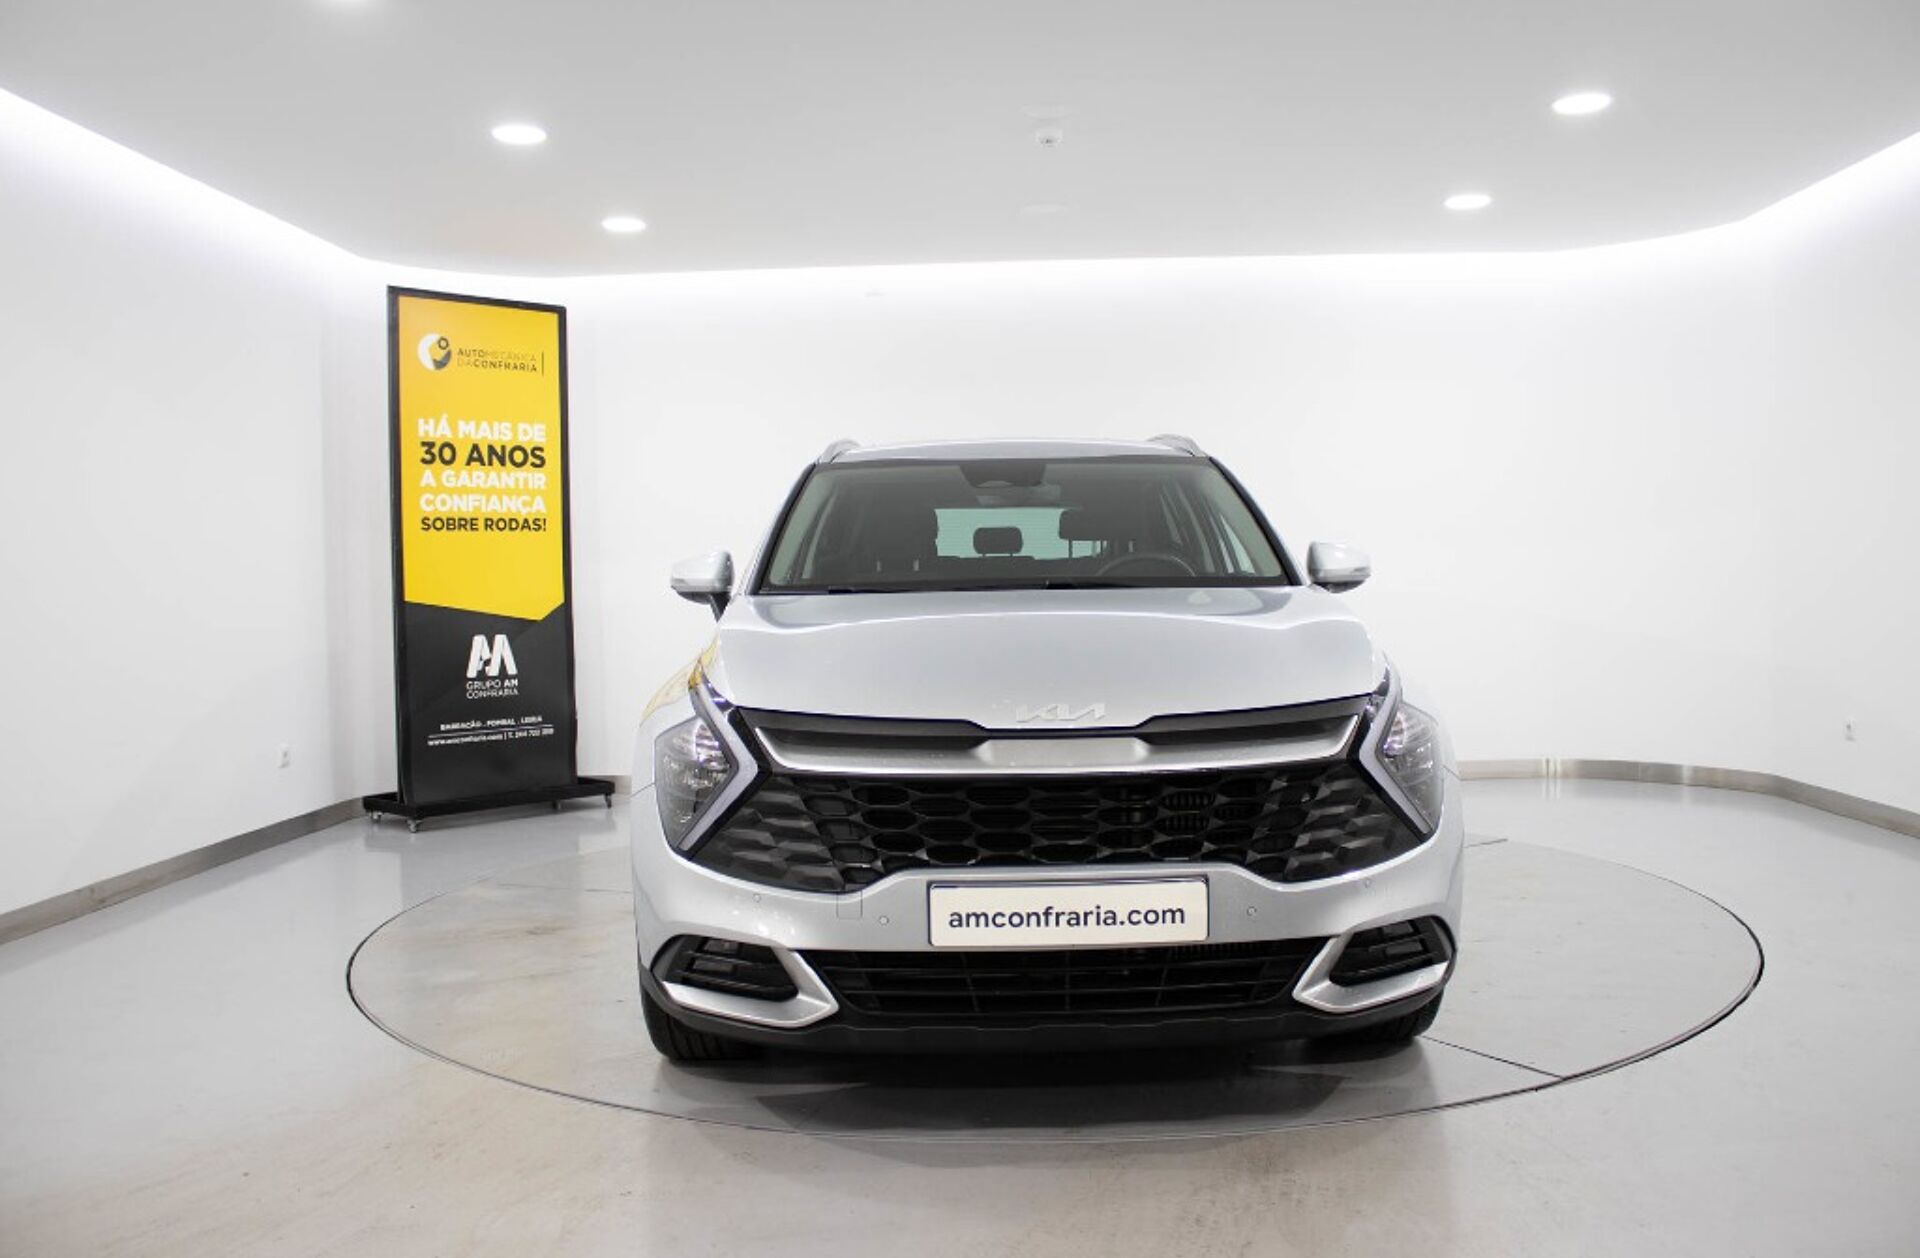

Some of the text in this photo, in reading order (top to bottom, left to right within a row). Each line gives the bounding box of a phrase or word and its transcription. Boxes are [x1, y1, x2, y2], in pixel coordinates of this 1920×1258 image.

[417, 413, 546, 442] HÁ MAIS DE
[420, 441, 546, 468] 30 ANOS
[420, 469, 546, 489] A GARANTIR
[419, 493, 546, 514] CONFIANÇA
[421, 517, 547, 532] SOBRE RODAS!
[466, 680, 501, 690] GRUPO
[948, 905, 1185, 928] amconfraria.com
